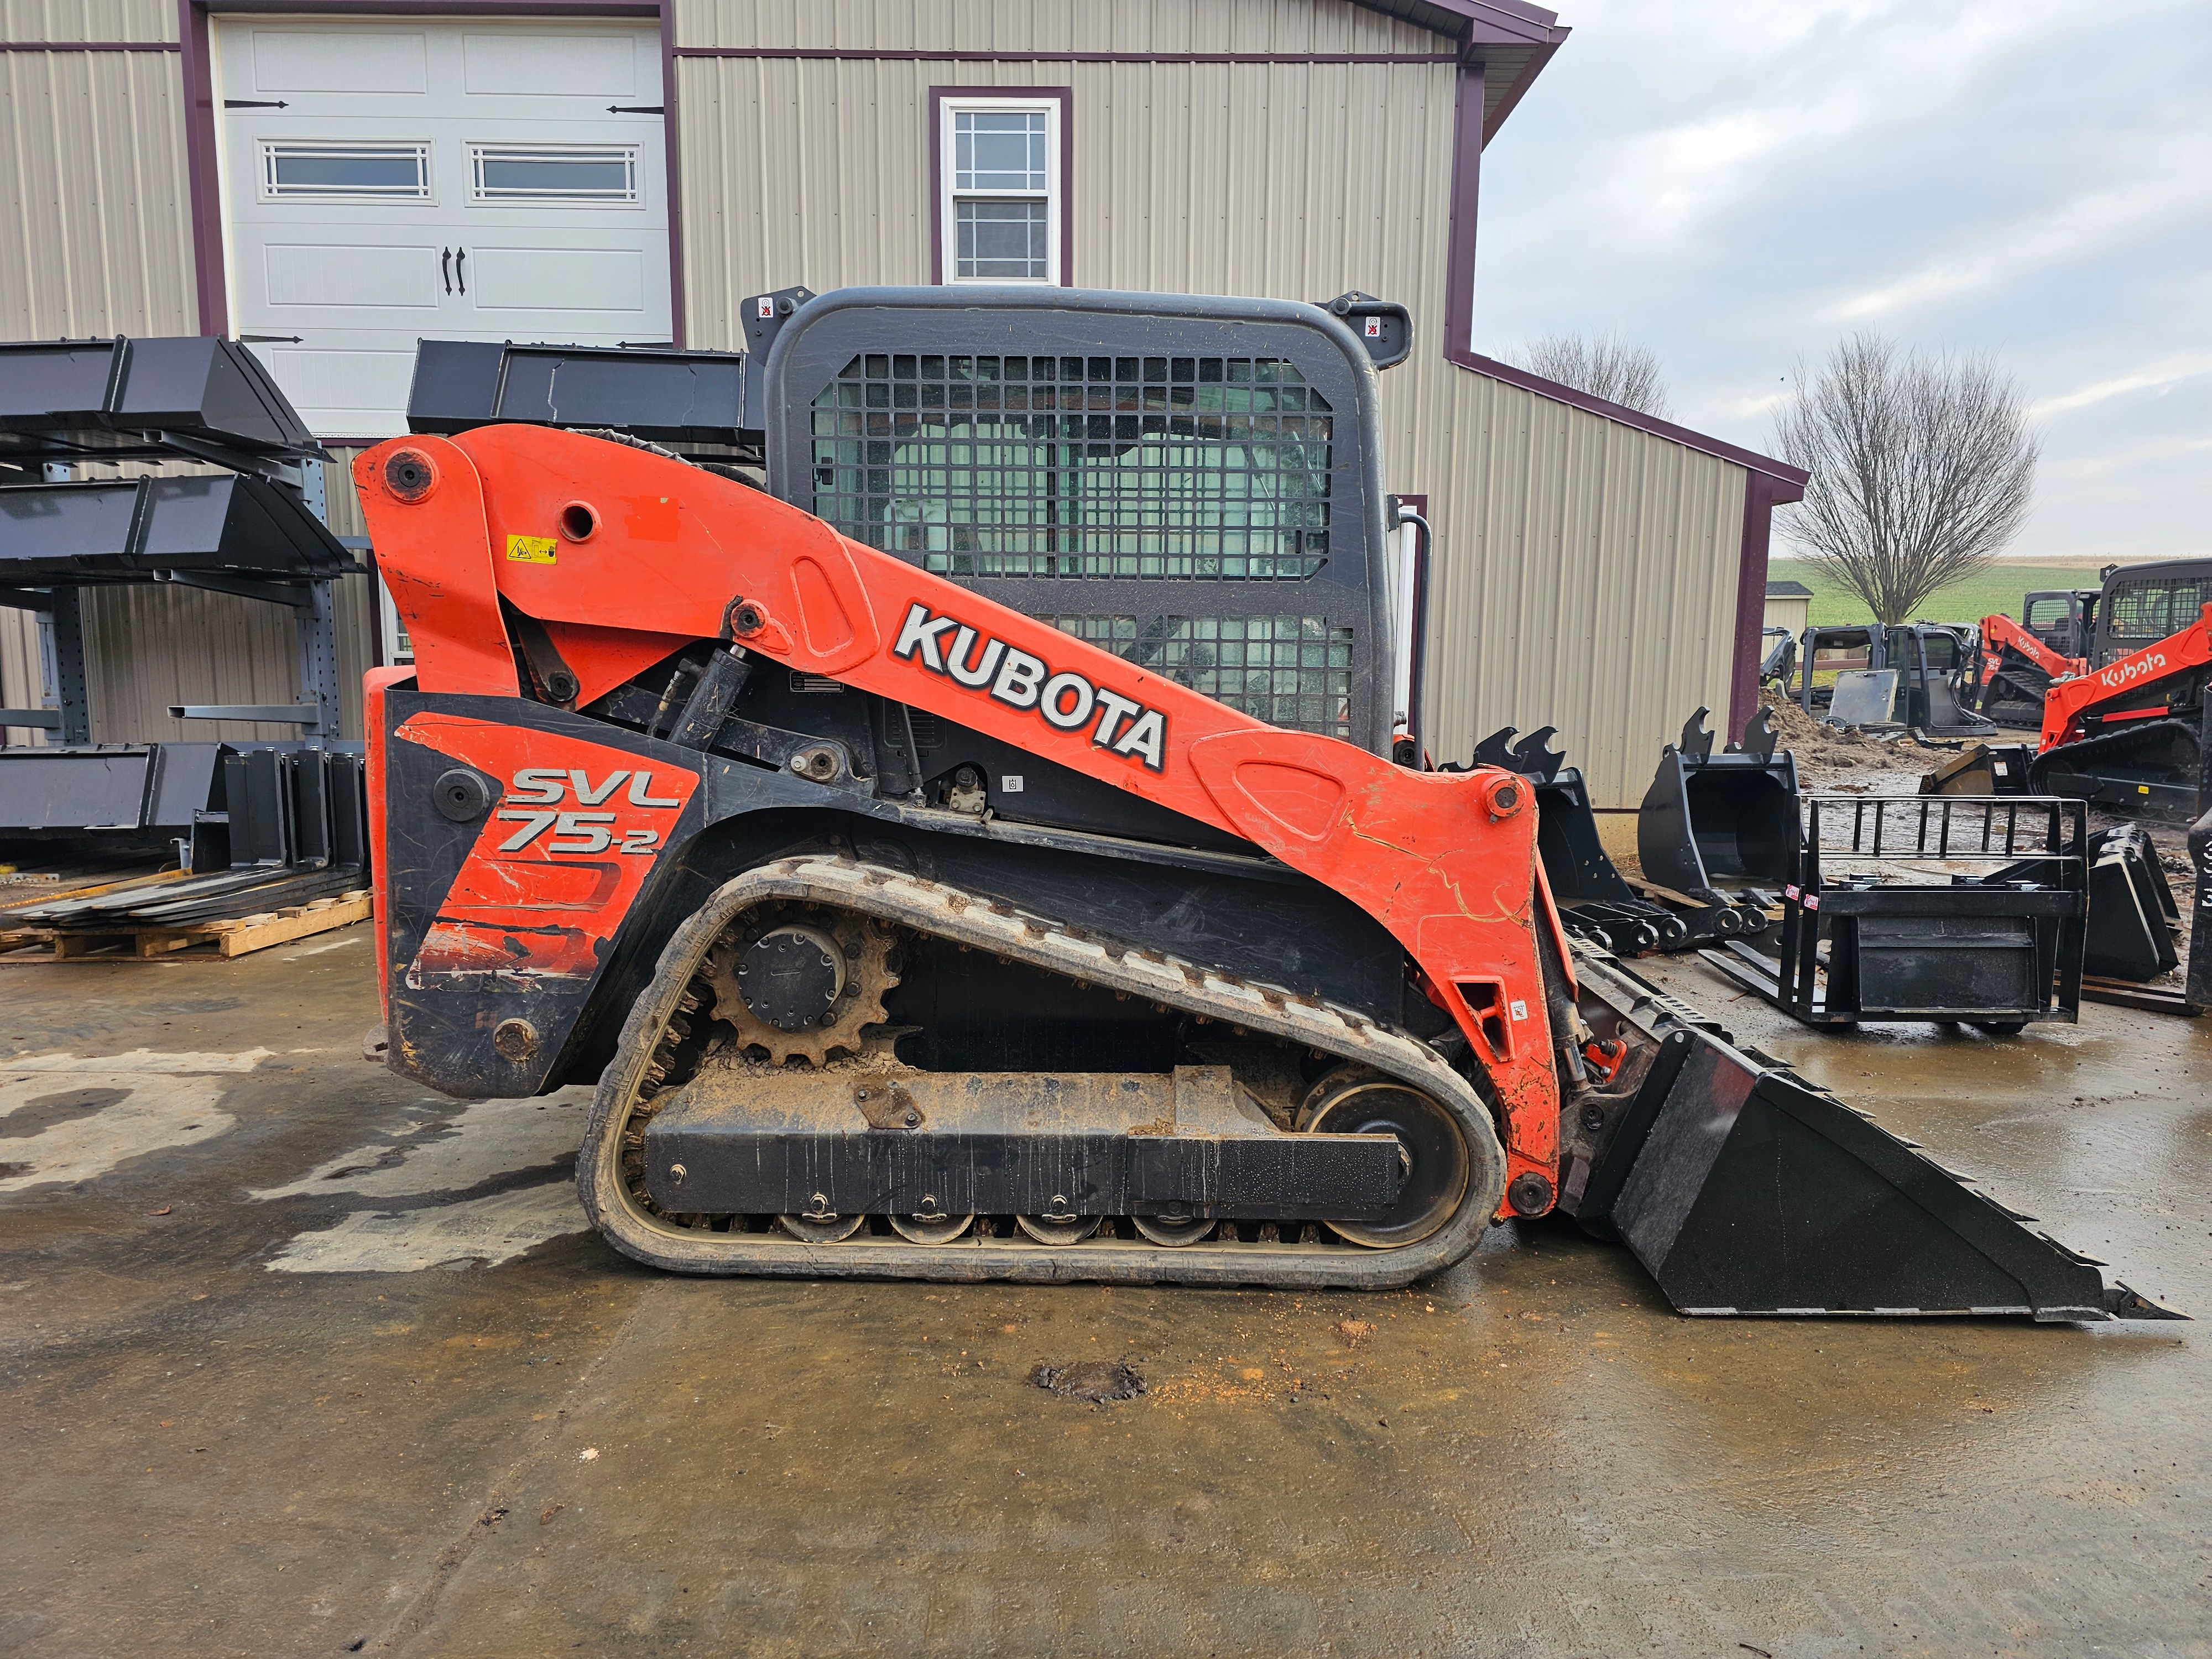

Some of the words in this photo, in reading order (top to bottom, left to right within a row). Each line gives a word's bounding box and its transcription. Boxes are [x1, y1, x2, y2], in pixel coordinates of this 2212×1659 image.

[2018, 635, 2040, 660] Kubota
[893, 602, 1165, 770] KUBOTA
[2101, 653, 2166, 687] Kubota
[504, 768, 680, 807] SVL
[497, 810, 659, 854] 75-2
